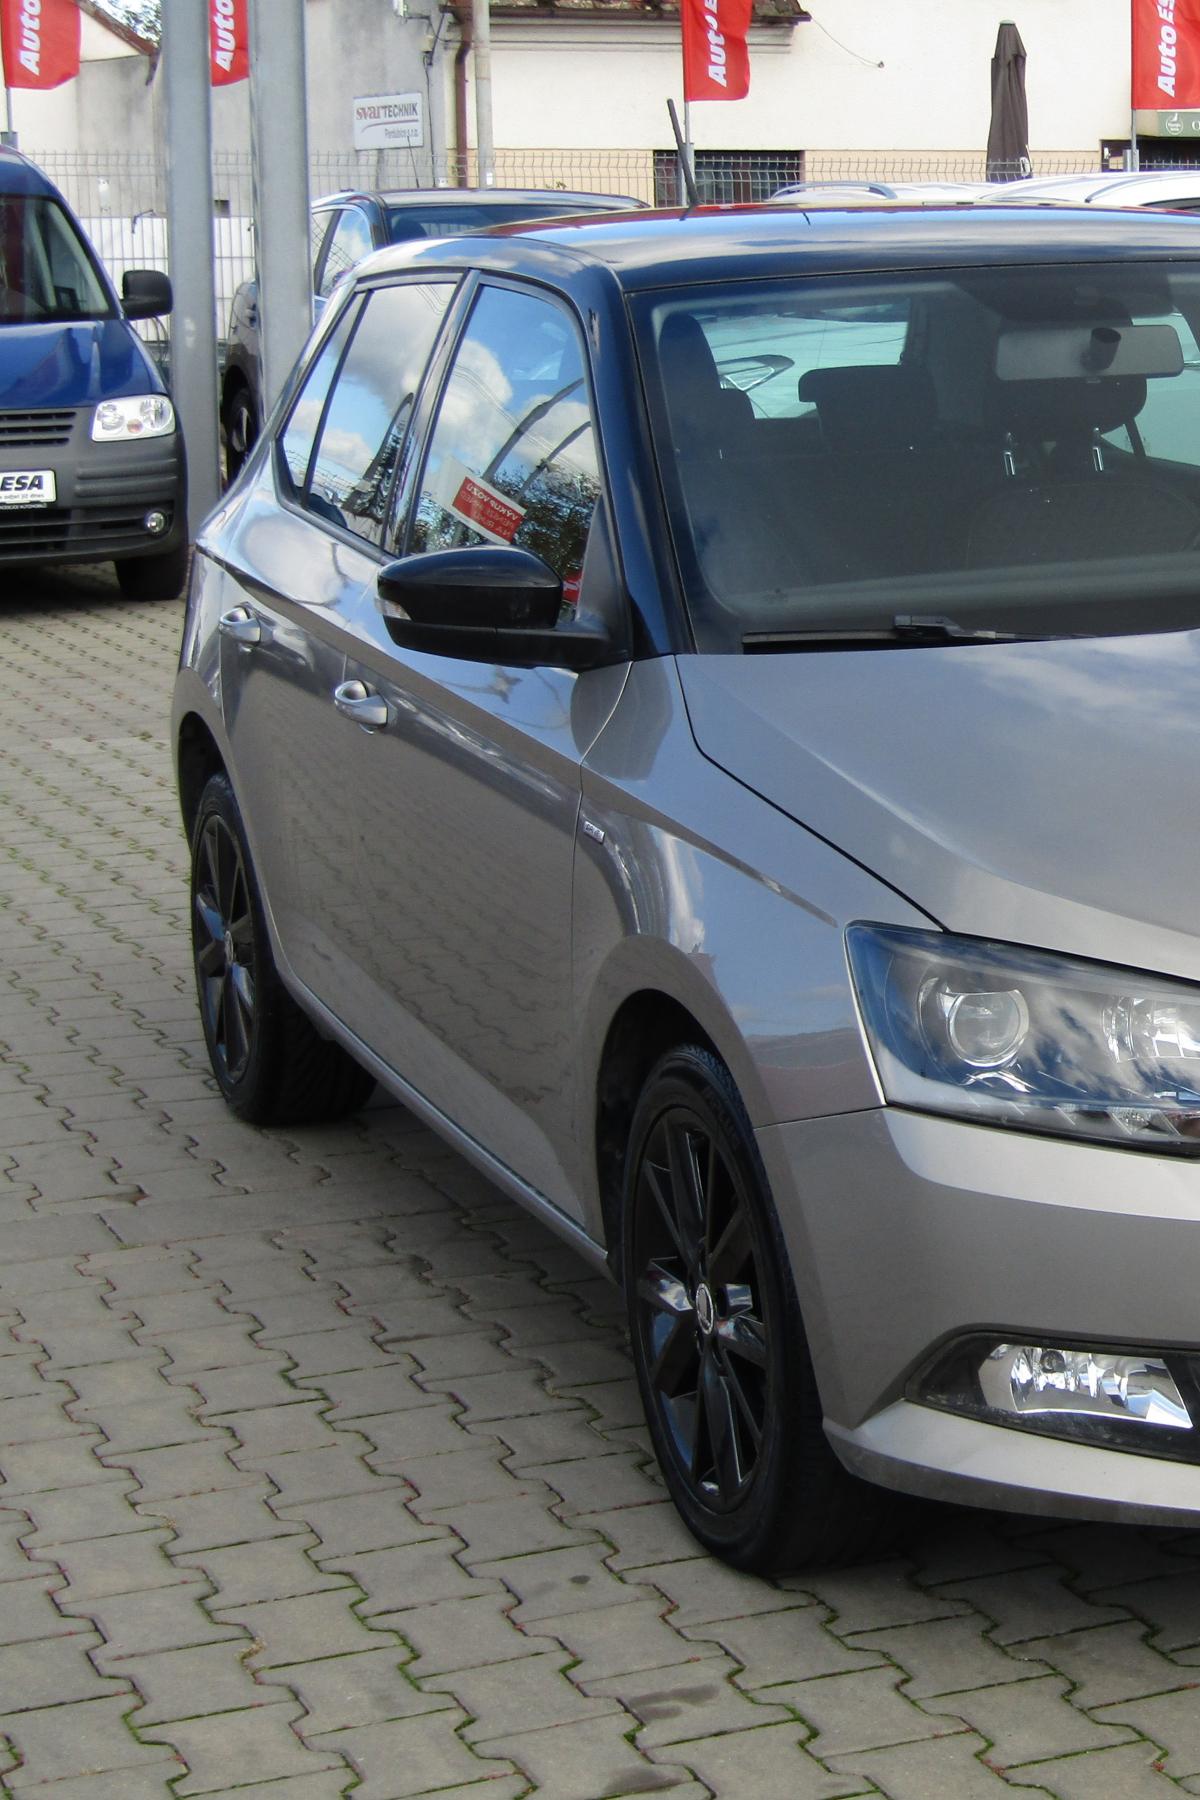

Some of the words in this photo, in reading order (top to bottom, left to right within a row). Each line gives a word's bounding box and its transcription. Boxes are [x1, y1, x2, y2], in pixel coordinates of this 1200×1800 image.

[704, 15, 727, 88] Auto
[1157, 25, 1177, 98] Auto
[0, 475, 44, 491] ESA
